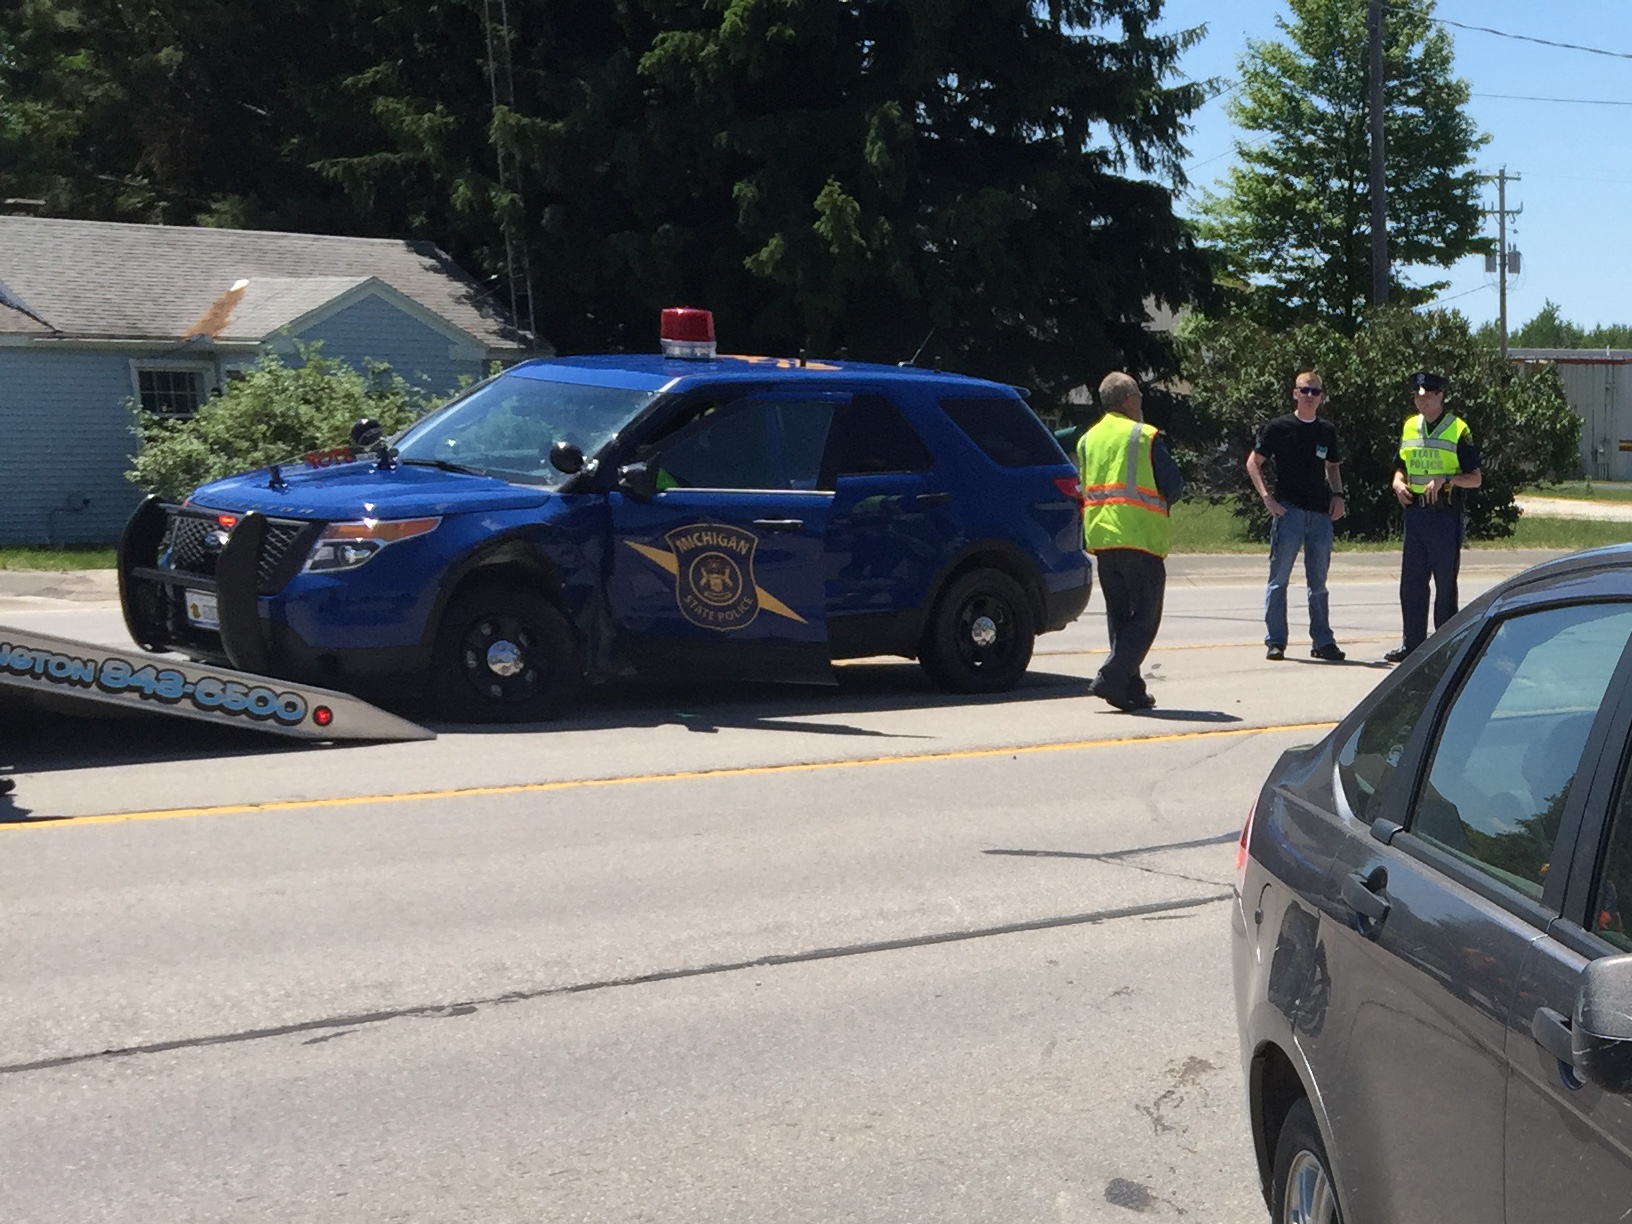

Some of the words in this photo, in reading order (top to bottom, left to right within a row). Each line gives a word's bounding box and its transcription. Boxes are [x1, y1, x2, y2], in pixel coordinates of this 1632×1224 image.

[1410, 459, 1443, 470] POLICE
[1412, 449, 1440, 458] STATE
[675, 531, 750, 555] MICHIGAN
[683, 594, 715, 621] STATE
[718, 595, 754, 622] POLICE
[99, 658, 307, 722] 843-6500
